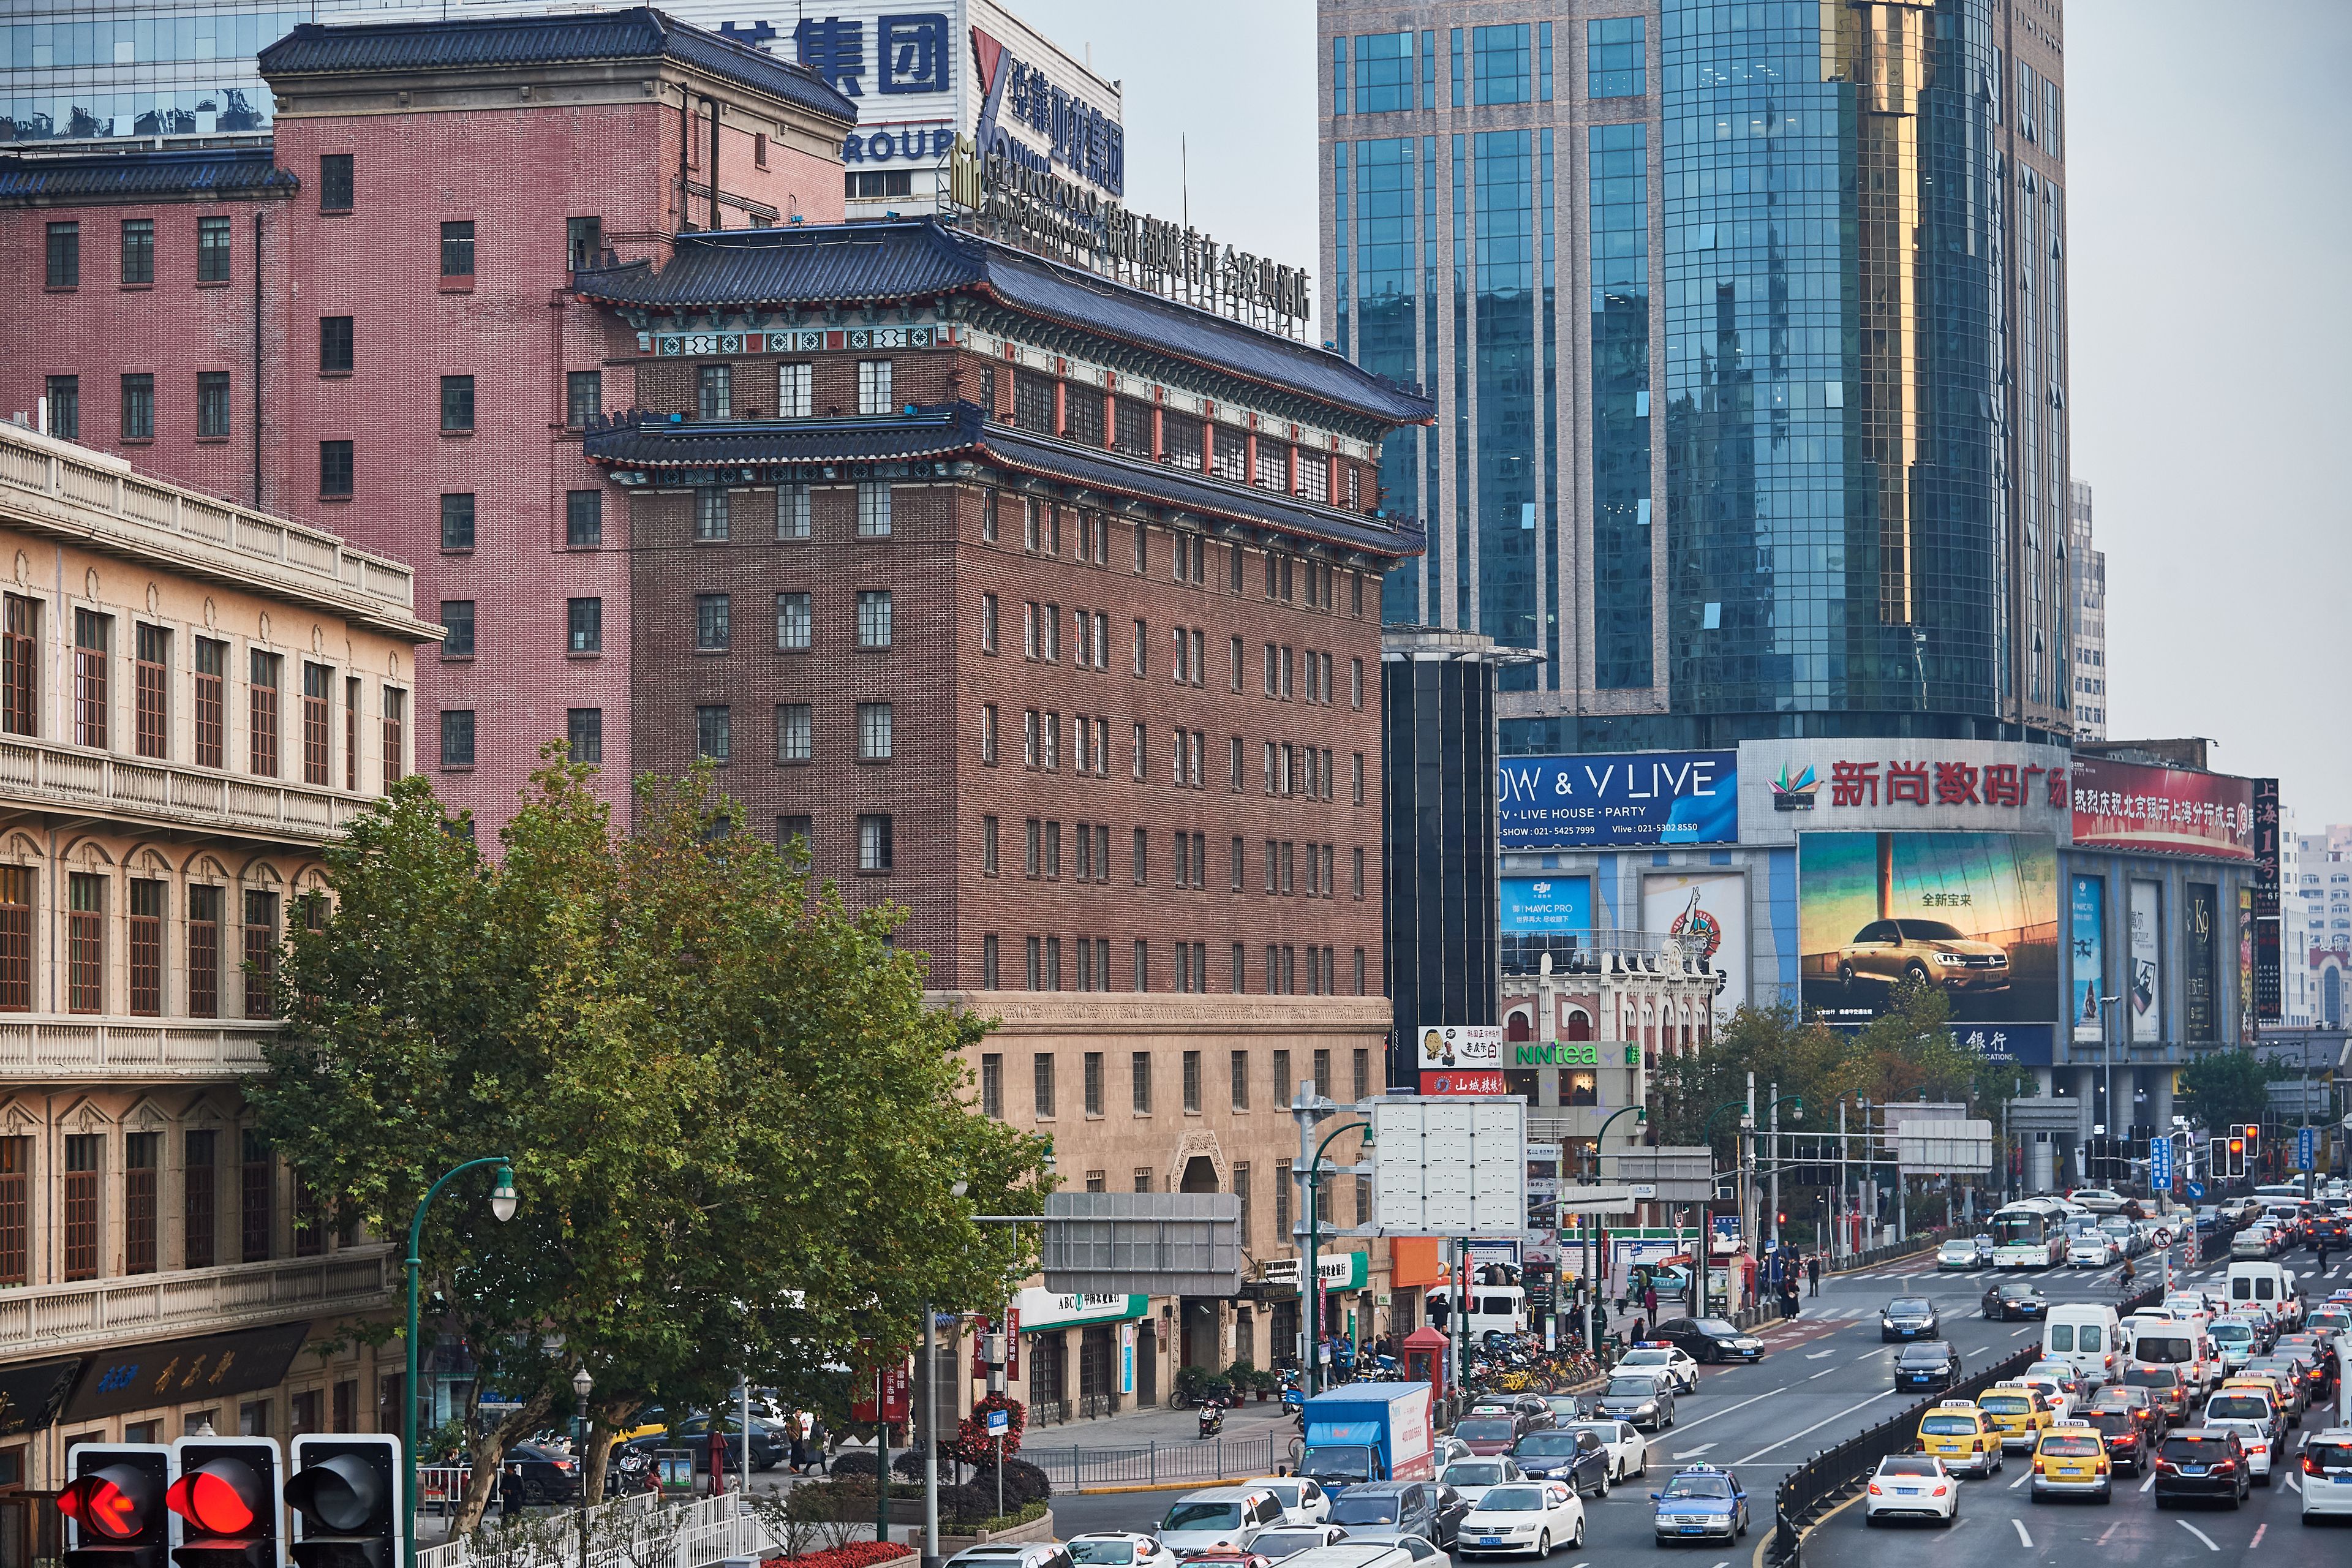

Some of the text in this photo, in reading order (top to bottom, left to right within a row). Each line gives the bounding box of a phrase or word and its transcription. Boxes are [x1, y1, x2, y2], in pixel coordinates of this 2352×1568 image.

[843, 129, 954, 163] ROUP
[984, 151, 1098, 216] METROPOLO
[990, 198, 1027, 227] JINJIANG
[1030, 214, 1061, 238] HOTELS
[1103, 200, 1312, 321] 锦江都城青年会经典酒店
[1555, 772, 1573, 794] &
[1585, 765, 1614, 797] V
[1628, 761, 1716, 798] LIVE
[1832, 760, 2068, 809] 新尚数码广场
[1521, 809, 1547, 820] LIVE
[1552, 808, 1594, 818] HOUSE
[1605, 806, 1646, 817] PARTY
[1678, 823, 1698, 832] 8550
[2256, 780, 2278, 880] 上海1号
[1555, 904, 1573, 913] PRO
[1922, 893, 1972, 907] 全新宝来
[2195, 900, 2209, 943] K9
[1059, 1296, 1074, 1310] ABC
